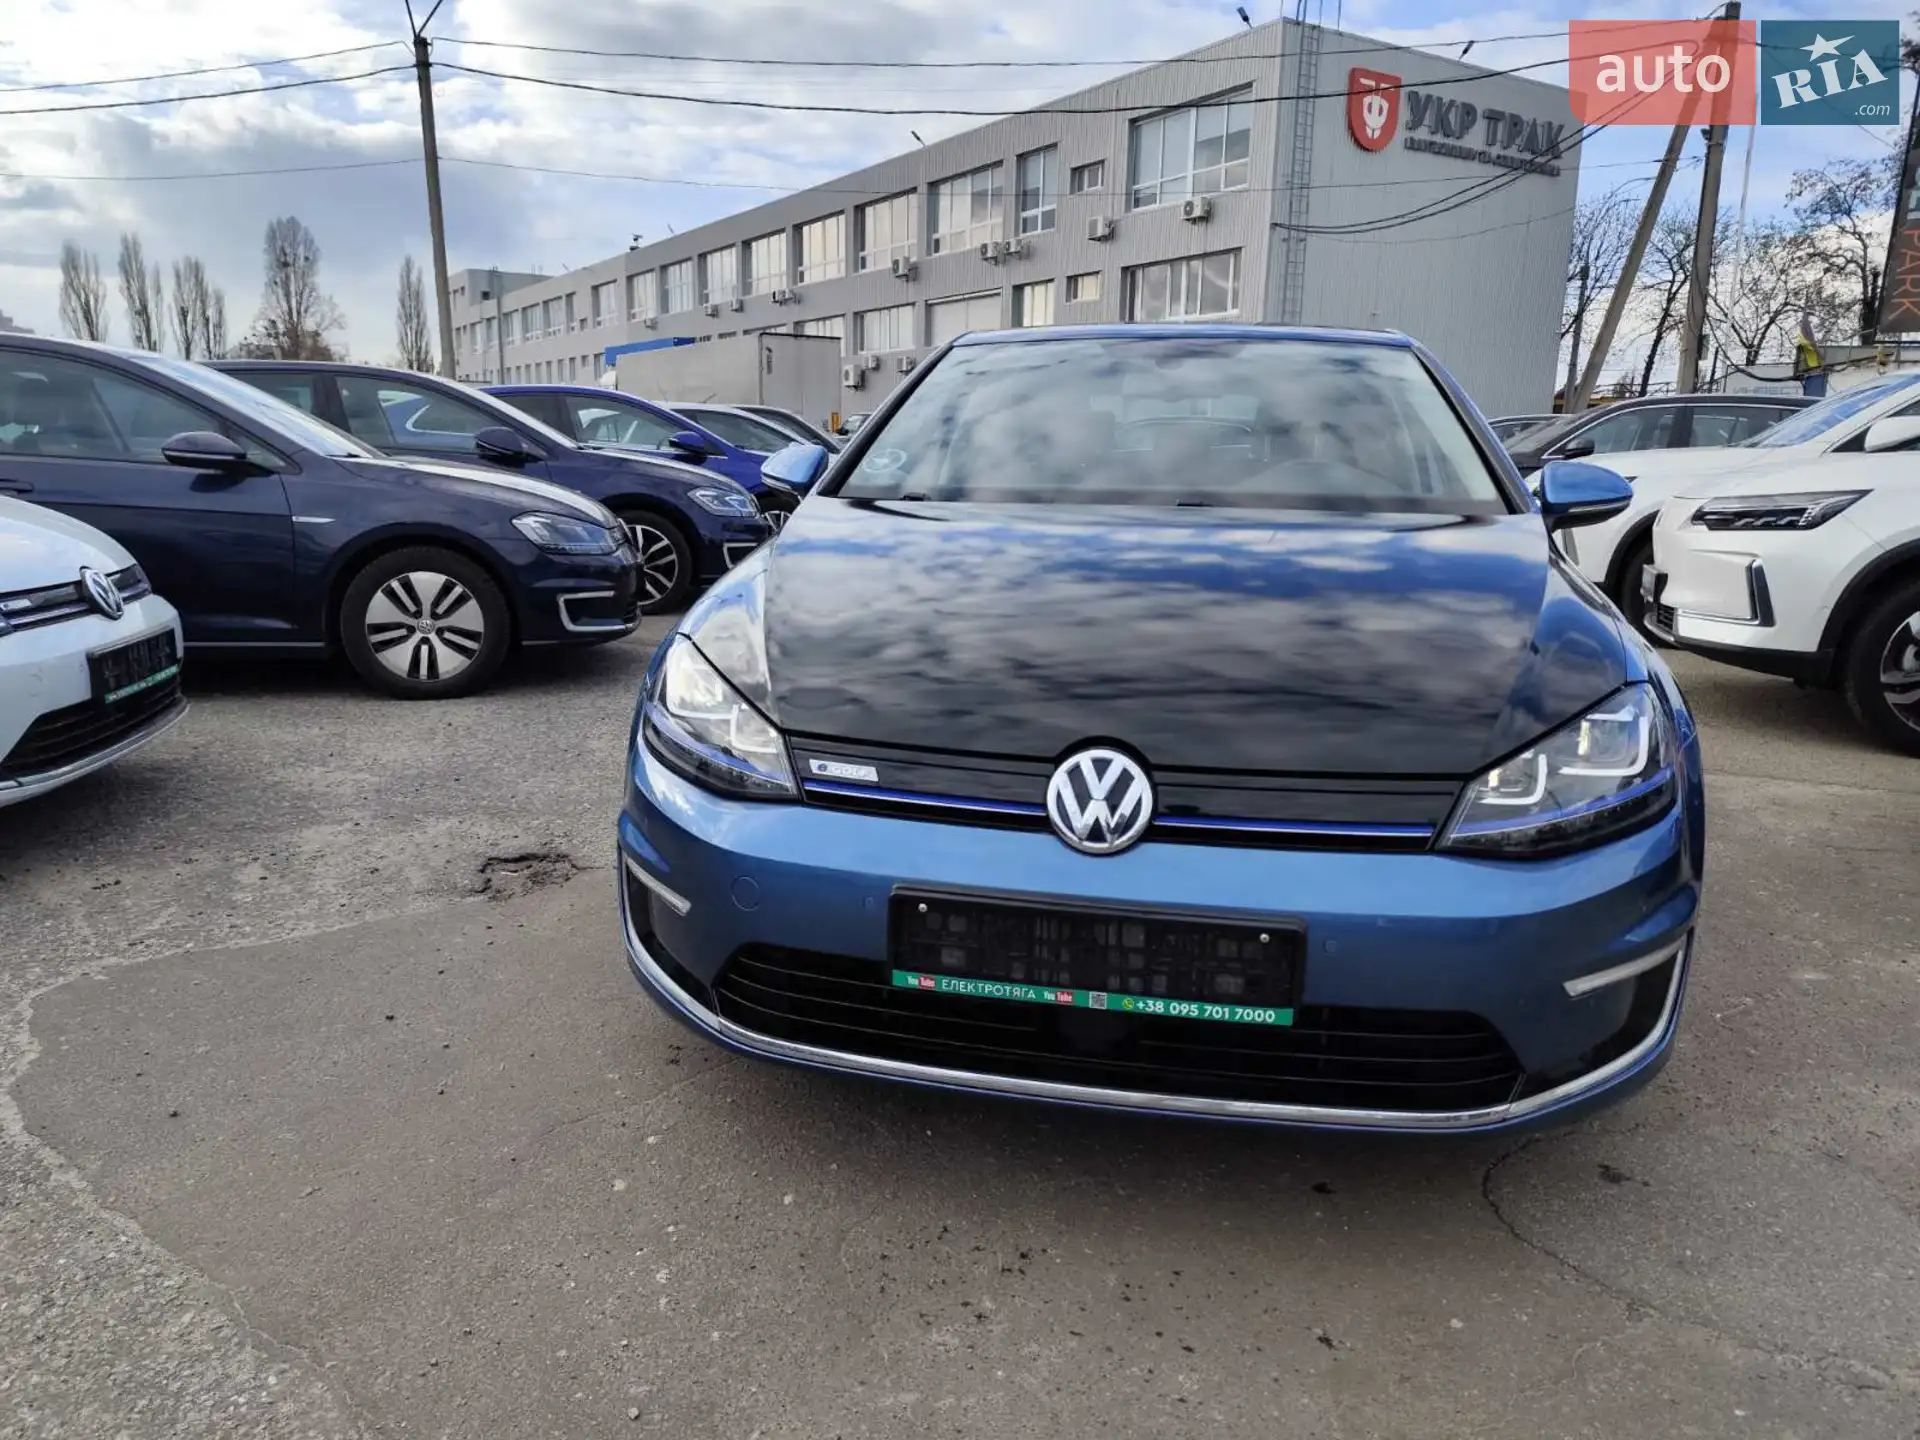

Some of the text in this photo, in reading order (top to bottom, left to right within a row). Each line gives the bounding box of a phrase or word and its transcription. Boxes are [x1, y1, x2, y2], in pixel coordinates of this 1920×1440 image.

[1405, 90, 1478, 139] УКР
[1482, 107, 1565, 159] ТРАК
[1888, 228, 1920, 320] PARK
[941, 979, 1036, 1000] ЕЛЕКТРОТЯГА
[1136, 1000, 1276, 1023] +38 095 701 7000
